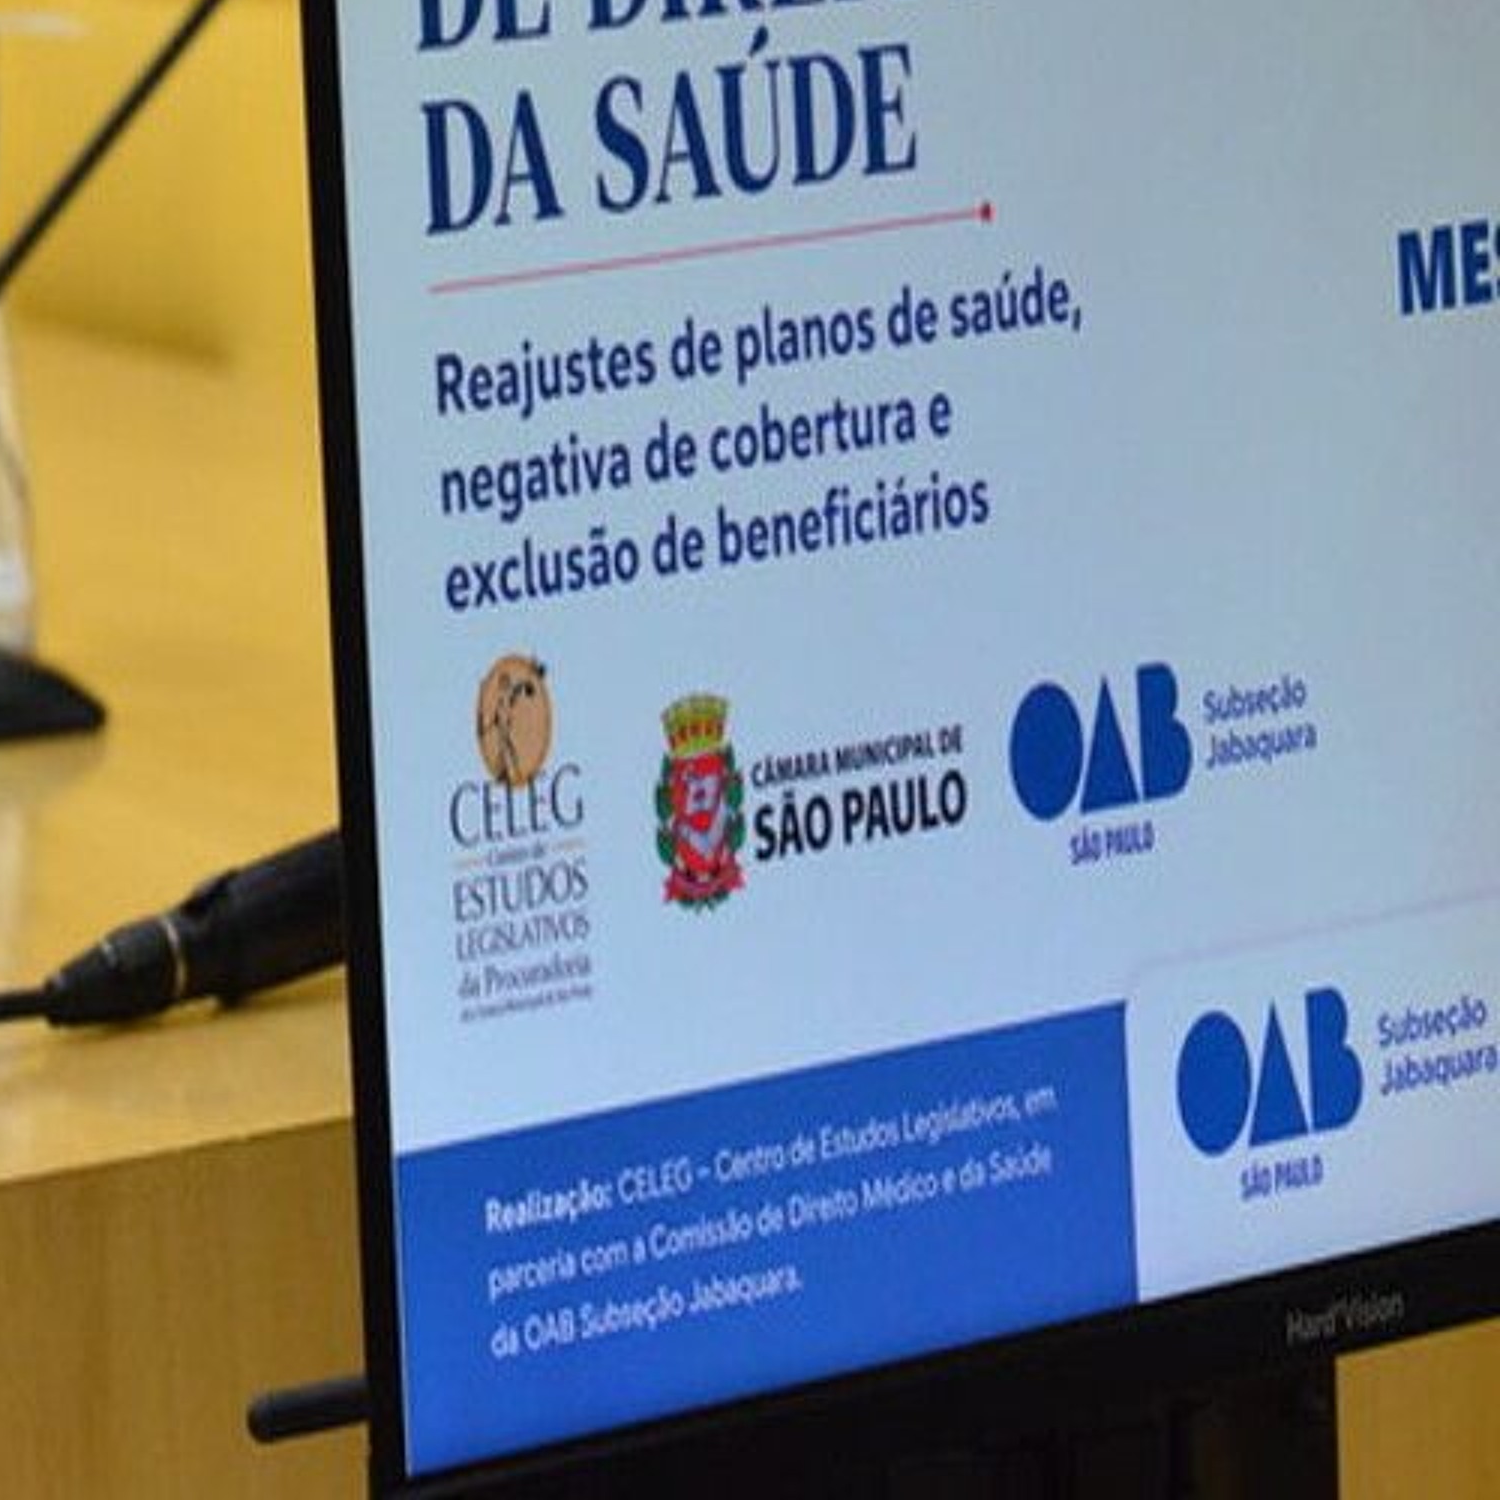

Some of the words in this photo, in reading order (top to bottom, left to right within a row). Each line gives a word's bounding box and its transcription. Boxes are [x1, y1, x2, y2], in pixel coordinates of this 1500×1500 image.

[421, 88, 565, 236] DA
[595, 24, 918, 214] SAÚDE
[1397, 217, 1500, 315] ME
[435, 340, 656, 421] Reajustes
[671, 318, 723, 382] de
[736, 305, 875, 385] planos
[888, 286, 938, 346] de
[950, 266, 1083, 336] saúde,
[441, 434, 631, 523] negativa
[644, 420, 697, 482] de
[710, 397, 916, 472] cobertura
[927, 393, 952, 437] e
[445, 527, 640, 611] exclusão
[653, 515, 705, 575] de
[717, 471, 990, 566] beneficiários
[1009, 661, 1193, 821] OAB
[1203, 675, 1307, 724] Subseção
[1206, 723, 1317, 769] Jabaquara
[751, 750, 830, 788] CÂMARA
[836, 730, 934, 774] MUNICIPAL
[939, 723, 962, 753] DE
[449, 763, 584, 848] CELEG
[753, 788, 832, 861] SÃO
[842, 769, 967, 844] PAULO
[453, 857, 589, 922] ESTUDOS
[1378, 997, 1487, 1047] Subseção
[1176, 987, 1363, 1158] OAB
[1381, 1045, 1498, 1096] Jabaquara
[485, 1179, 612, 1231] Realização:
[618, 1156, 692, 1203] CELEG
[714, 1143, 784, 1183] Centro
[790, 1132, 816, 1166] de
[820, 1117, 899, 1159] Estudos
[488, 1249, 576, 1302] parceria
[581, 1242, 628, 1275] com
[633, 1236, 647, 1264] a
[650, 1208, 752, 1260] Comissão
[757, 1202, 784, 1237] de
[788, 1190, 858, 1227] Direito
[959, 1157, 985, 1191] da
[492, 1322, 519, 1358] da
[524, 1306, 574, 1350] OAB
[579, 1285, 684, 1339] Subseção
